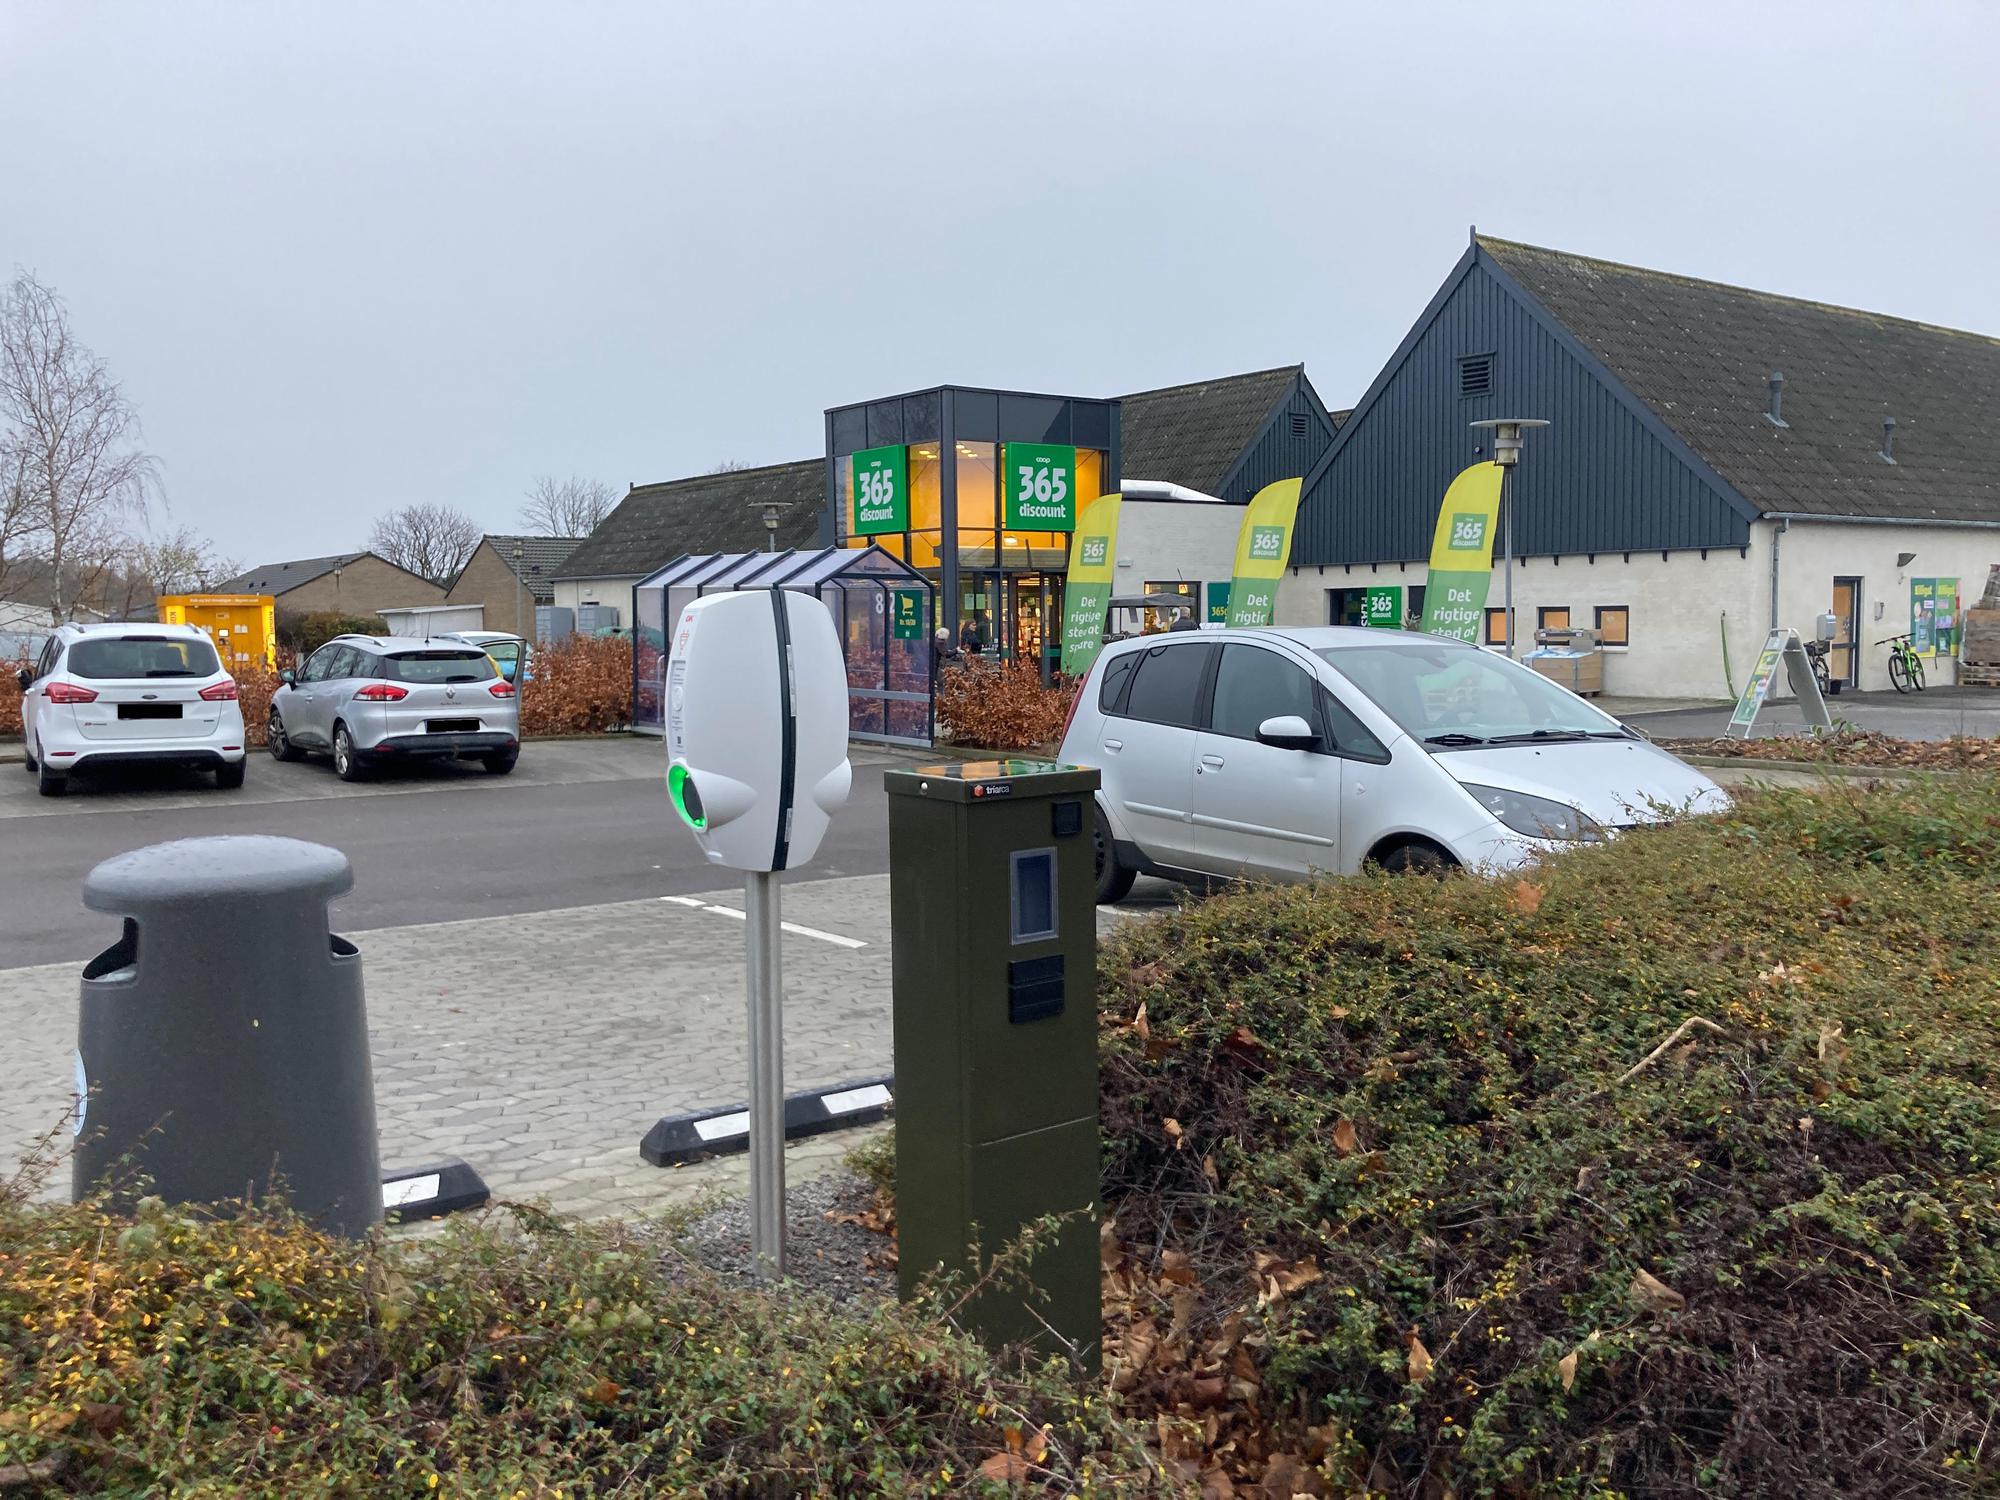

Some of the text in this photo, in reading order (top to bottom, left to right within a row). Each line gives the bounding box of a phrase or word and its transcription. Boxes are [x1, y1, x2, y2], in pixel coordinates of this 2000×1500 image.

[859, 469, 894, 507] 365
[1018, 465, 1067, 503] 365
[860, 506, 894, 522] discount
[1019, 503, 1067, 518] discount
[1454, 522, 1482, 539] 365
[1254, 534, 1279, 549] 365
[1083, 543, 1104, 557] 365
[1081, 596, 1097, 608] Det
[1247, 594, 1268, 606] Det
[1447, 588, 1472, 602] Det
[1371, 596, 1392, 612] 365
[1433, 606, 1480, 624] rigtige
[1088, 624, 1100, 635] at
[1464, 625, 1476, 638] at
[986, 785, 1010, 794] triarca
